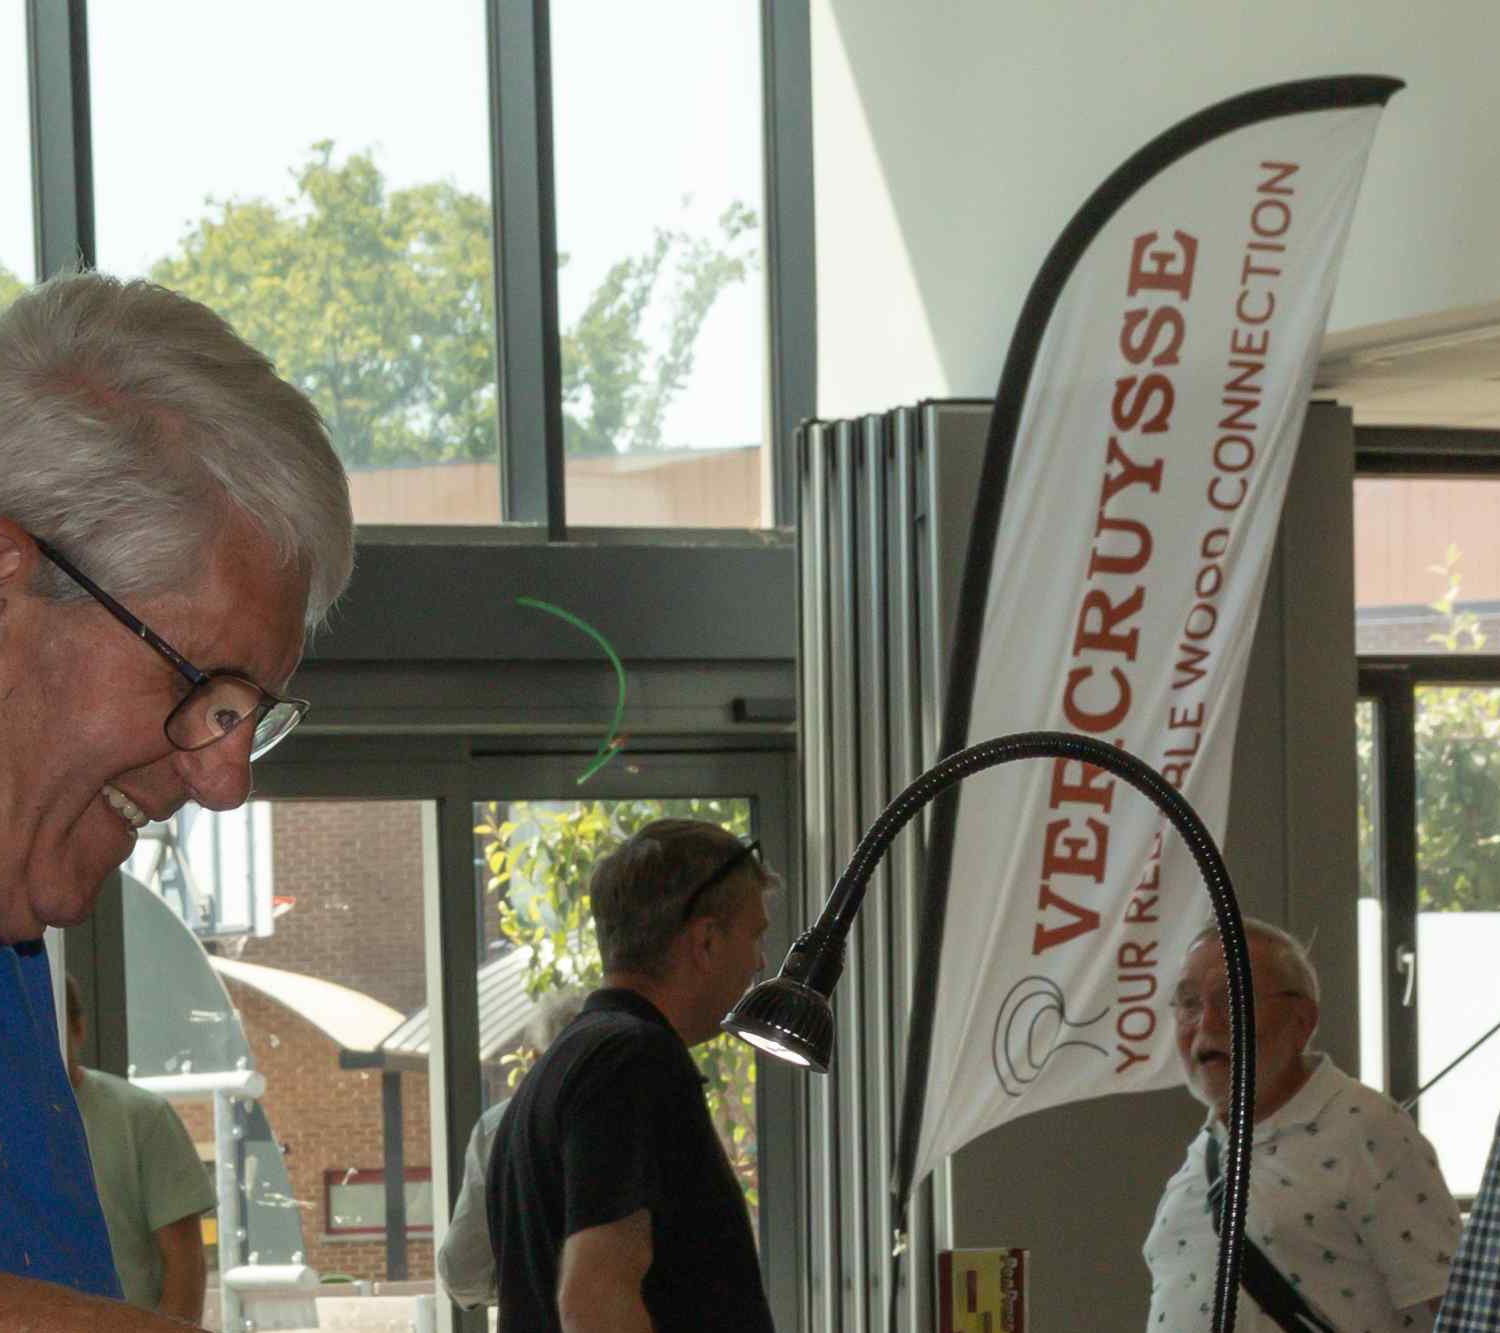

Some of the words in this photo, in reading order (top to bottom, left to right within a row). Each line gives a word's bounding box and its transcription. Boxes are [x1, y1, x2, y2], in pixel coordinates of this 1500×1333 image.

[1032, 228, 1198, 955] VERCRUYSSE
[1116, 940, 1160, 1074] YOUR
[1208, 159, 1300, 512] CONNECTION
